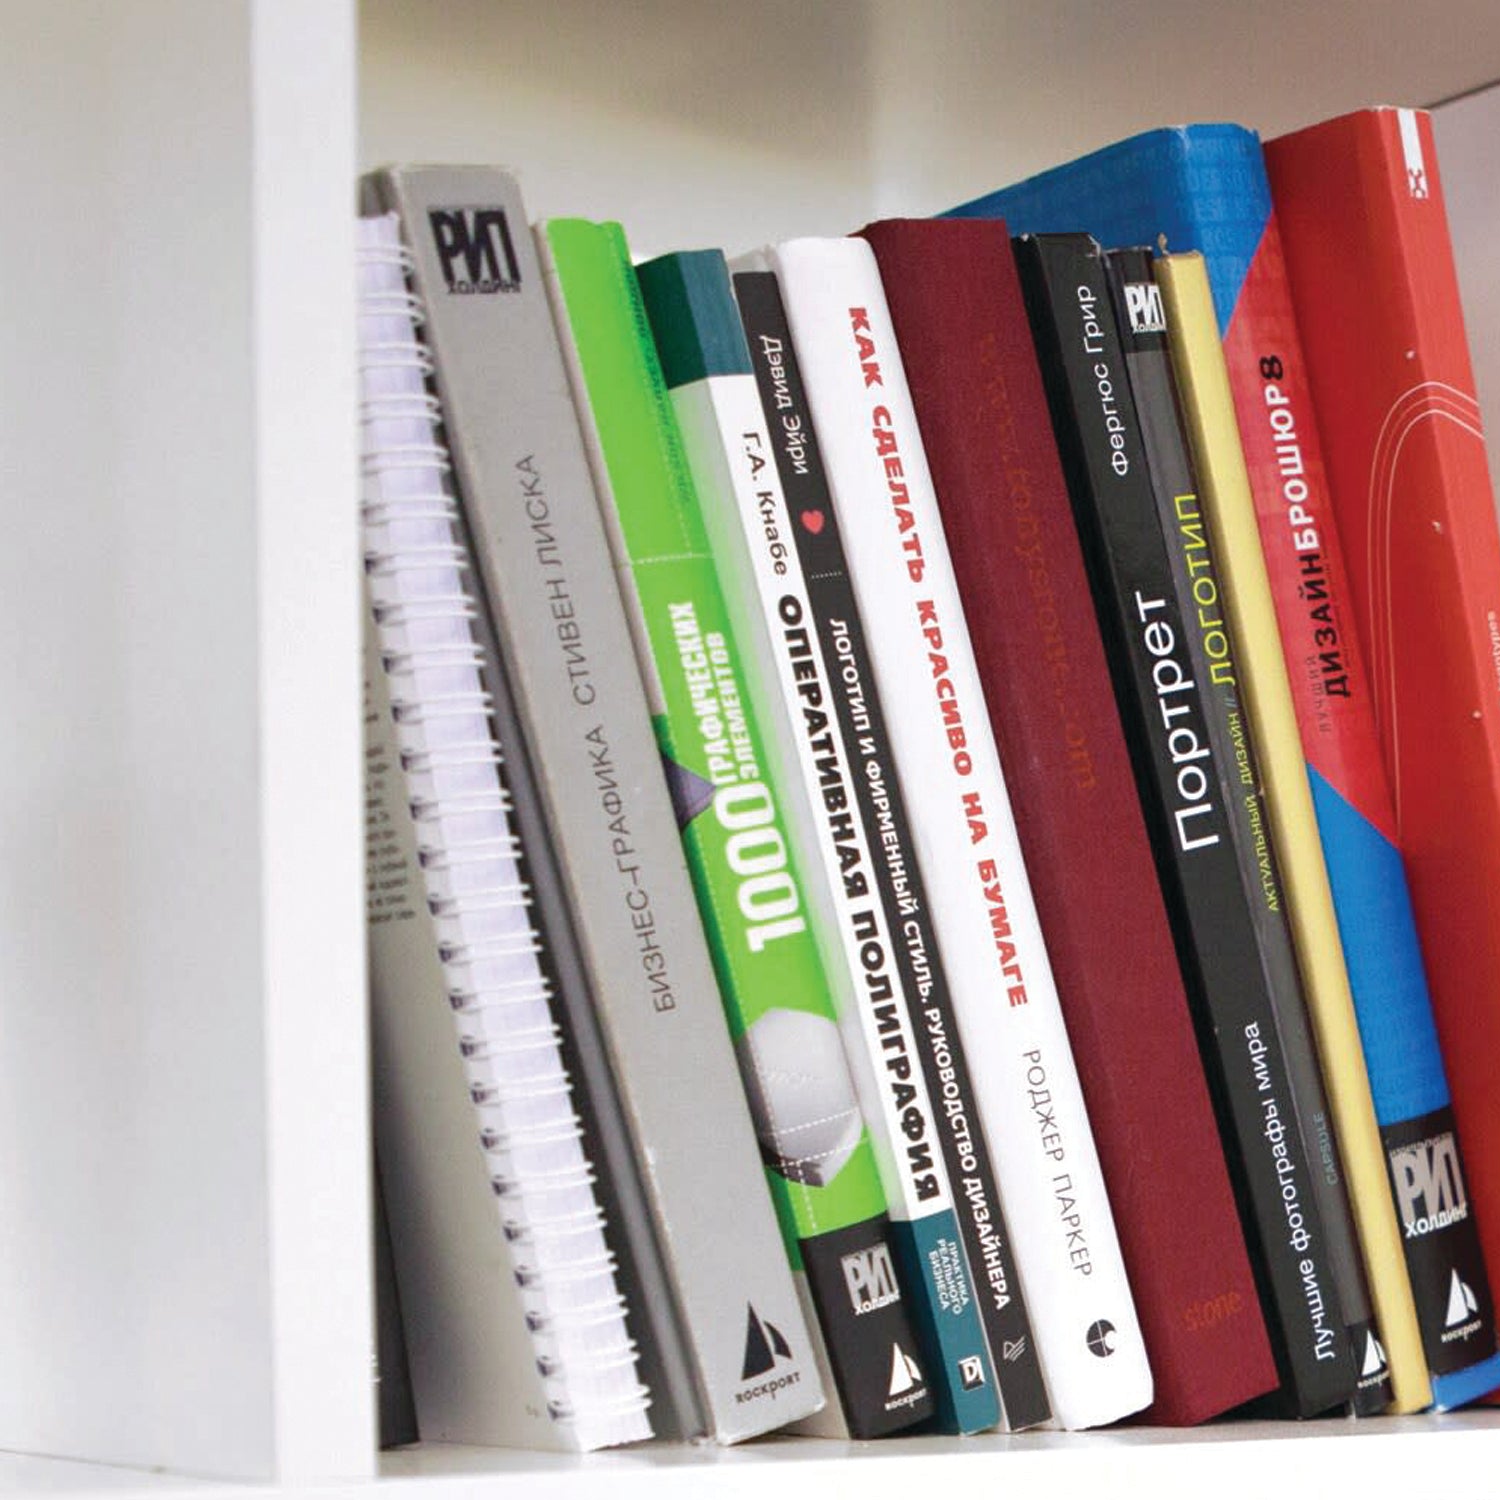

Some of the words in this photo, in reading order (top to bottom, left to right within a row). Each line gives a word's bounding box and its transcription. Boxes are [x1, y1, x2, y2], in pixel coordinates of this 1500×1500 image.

[427, 208, 522, 288] РИП
[1077, 284, 1103, 355] Грир
[1123, 285, 1168, 333] РИП
[760, 334, 791, 410] Дэвид
[782, 409, 809, 475] Эйри
[1095, 362, 1129, 476] Фергюс
[516, 454, 570, 573] ЛИСКА
[546, 577, 597, 707] СТИВЕН
[1173, 494, 1236, 685] ЛОГОТИП
[668, 602, 738, 784] ГРАФИЧЕСКИХ
[706, 632, 759, 781] ЭЛЕМЕНТОВ
[829, 618, 871, 735] ЛОГОТИП
[848, 306, 884, 387] КАК
[872, 405, 926, 583] СДЕЛАТЬ
[915, 600, 973, 776] КРАСИВО
[961, 793, 986, 846] НА
[978, 859, 1028, 1009] БУМАГЕ
[861, 739, 875, 756] И
[1136, 592, 1220, 852] Портрет
[1228, 712, 1254, 786] ДИЗАЙН
[596, 723, 675, 1014] БИЗНЕС-ГРАФИКА
[714, 779, 806, 953] 1000
[741, 432, 764, 481] Г.А.
[756, 493, 789, 577] Кнабе
[778, 593, 871, 899] ОПЕРАТИВНАЯ
[854, 914, 941, 1202] ПОЛИГРАФИЯ
[864, 760, 920, 915] ФИРМЕННЫЙ
[1246, 796, 1281, 913] АКТУАЛЬНЫЙ
[925, 1007, 976, 1170] РУКОВОДСТВО
[1244, 1021, 1273, 1092] мира
[1022, 1050, 1066, 1163] РОДЖЕР
[1051, 1176, 1093, 1279] ПАРКЕР
[1262, 1096, 1312, 1254] фотографы
[1313, 1111, 1339, 1187] CAPSULE
[936, 1238, 963, 1315] РЕАЛЬНОГО
[962, 1175, 1011, 1311] ДИЗАЙНЕРА
[1404, 1202, 1468, 1239] ХОЛДИНГ
[927, 1250, 951, 1311] БИЗНЕСА
[1298, 1258, 1336, 1362] Лучшие
[735, 1371, 801, 1403] ROCKPORT
